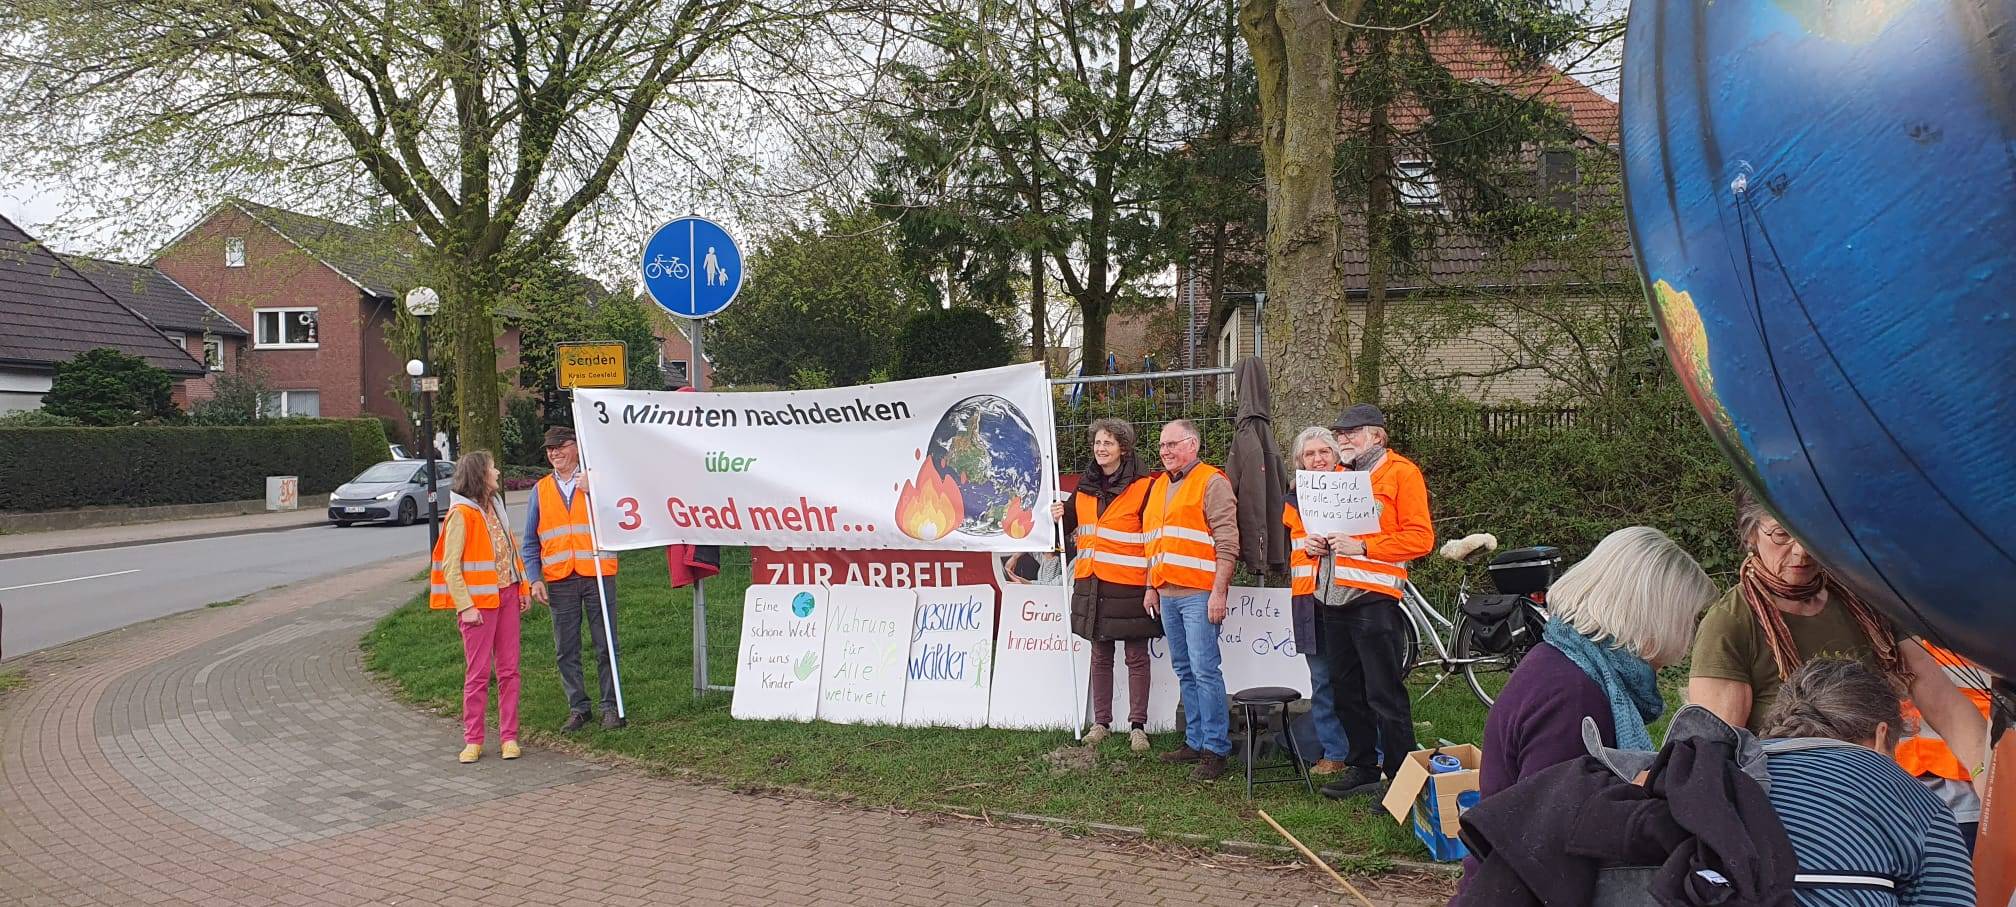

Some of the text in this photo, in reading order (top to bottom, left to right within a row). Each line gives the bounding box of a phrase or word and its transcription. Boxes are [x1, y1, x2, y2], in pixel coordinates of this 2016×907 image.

[568, 354, 616, 366] Senden
[594, 398, 911, 427] 3 Minuten nachdenken
[705, 451, 757, 473] über
[1311, 474, 1327, 490] LG
[1330, 477, 1360, 491] sind
[616, 496, 875, 532] 3 Grad mehr...
[1323, 510, 1342, 519] was
[767, 562, 964, 588] ZUR ARBEIT
[755, 597, 780, 613] Eine
[1240, 595, 1281, 618] Platz
[788, 620, 817, 638] Welt
[828, 604, 897, 638] Nahrung
[912, 594, 983, 644] gesunde
[1007, 630, 1082, 652] Innenstäde
[768, 654, 791, 664] uns
[761, 671, 795, 689] Kinder
[833, 662, 873, 681] Alle
